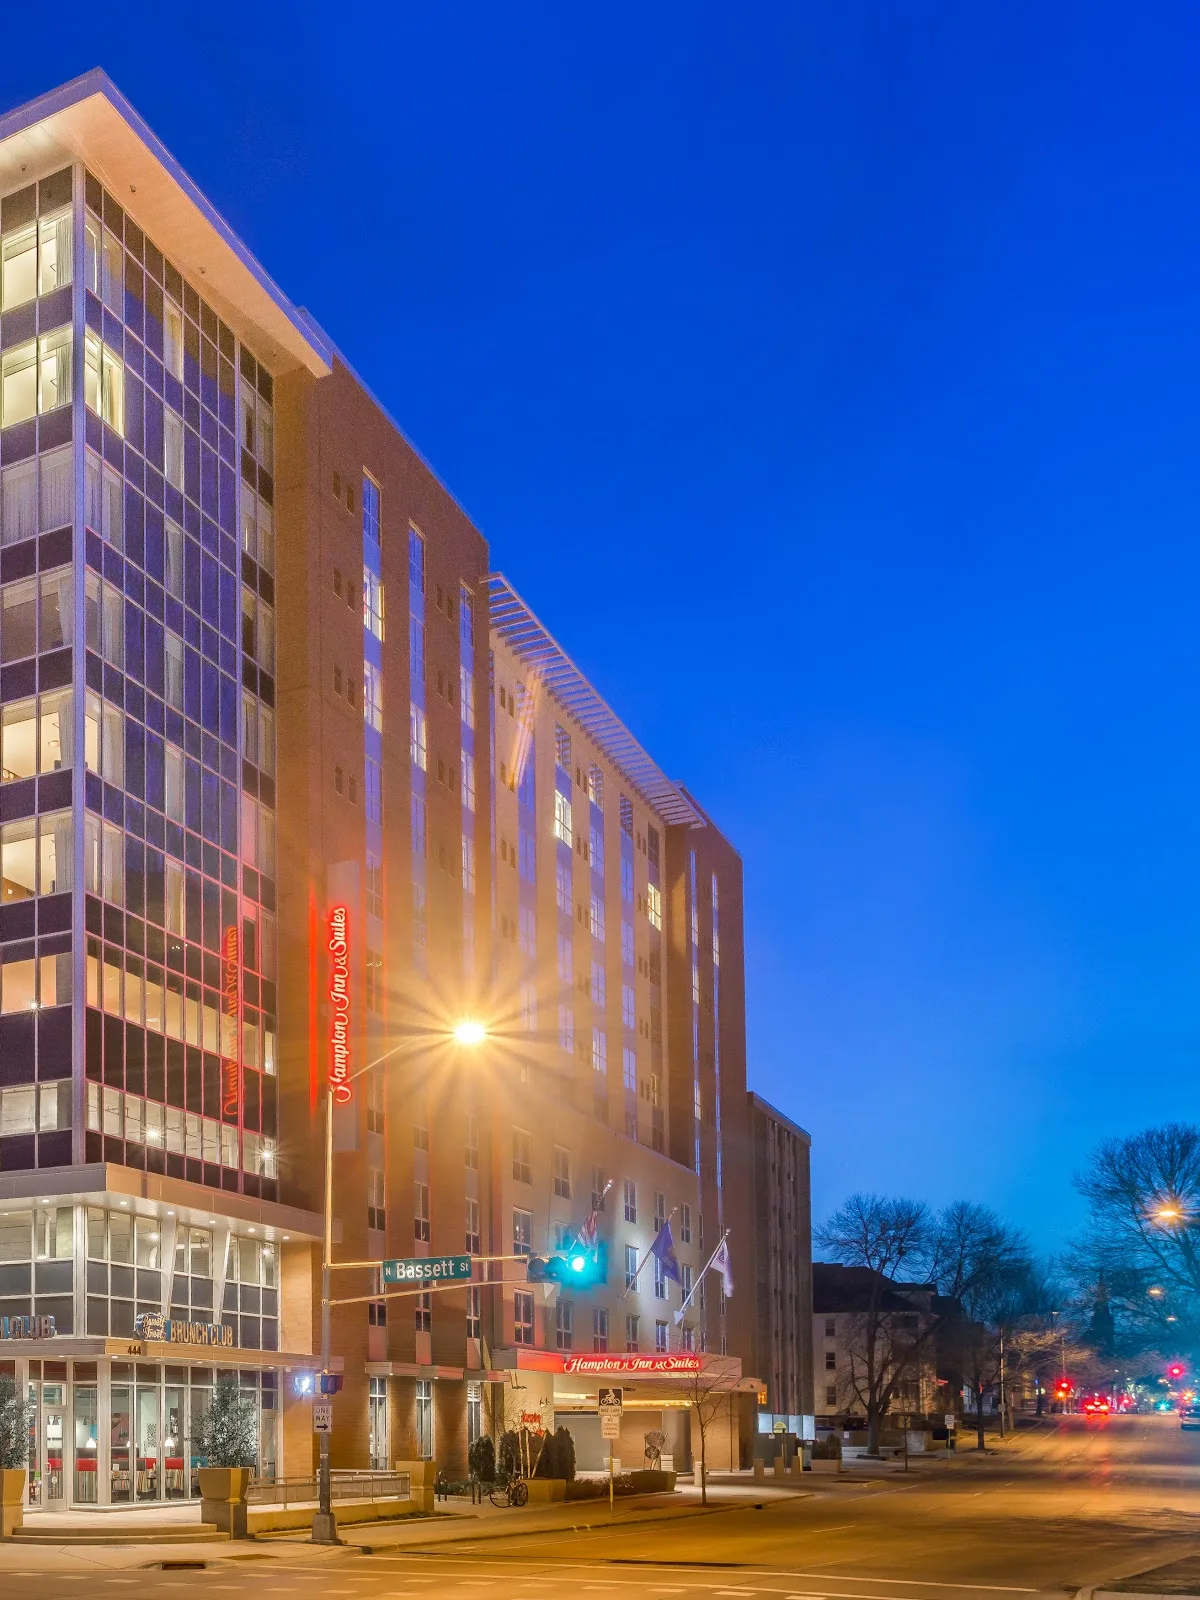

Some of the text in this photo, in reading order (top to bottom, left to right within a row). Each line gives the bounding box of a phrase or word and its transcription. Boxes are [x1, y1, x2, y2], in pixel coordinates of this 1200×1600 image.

[329, 907, 347, 957] Suites
[334, 956, 347, 966] &
[330, 965, 349, 1011] Inn
[385, 1259, 469, 1279] N Bassett St
[10, 1314, 53, 1339] CLUB
[142, 1316, 167, 1328] Bassett
[143, 1326, 167, 1340] Street
[171, 1320, 233, 1347] BRUNCH CLUB
[127, 1345, 141, 1355] 444
[564, 1357, 699, 1373] Hampton Inn & Suites
